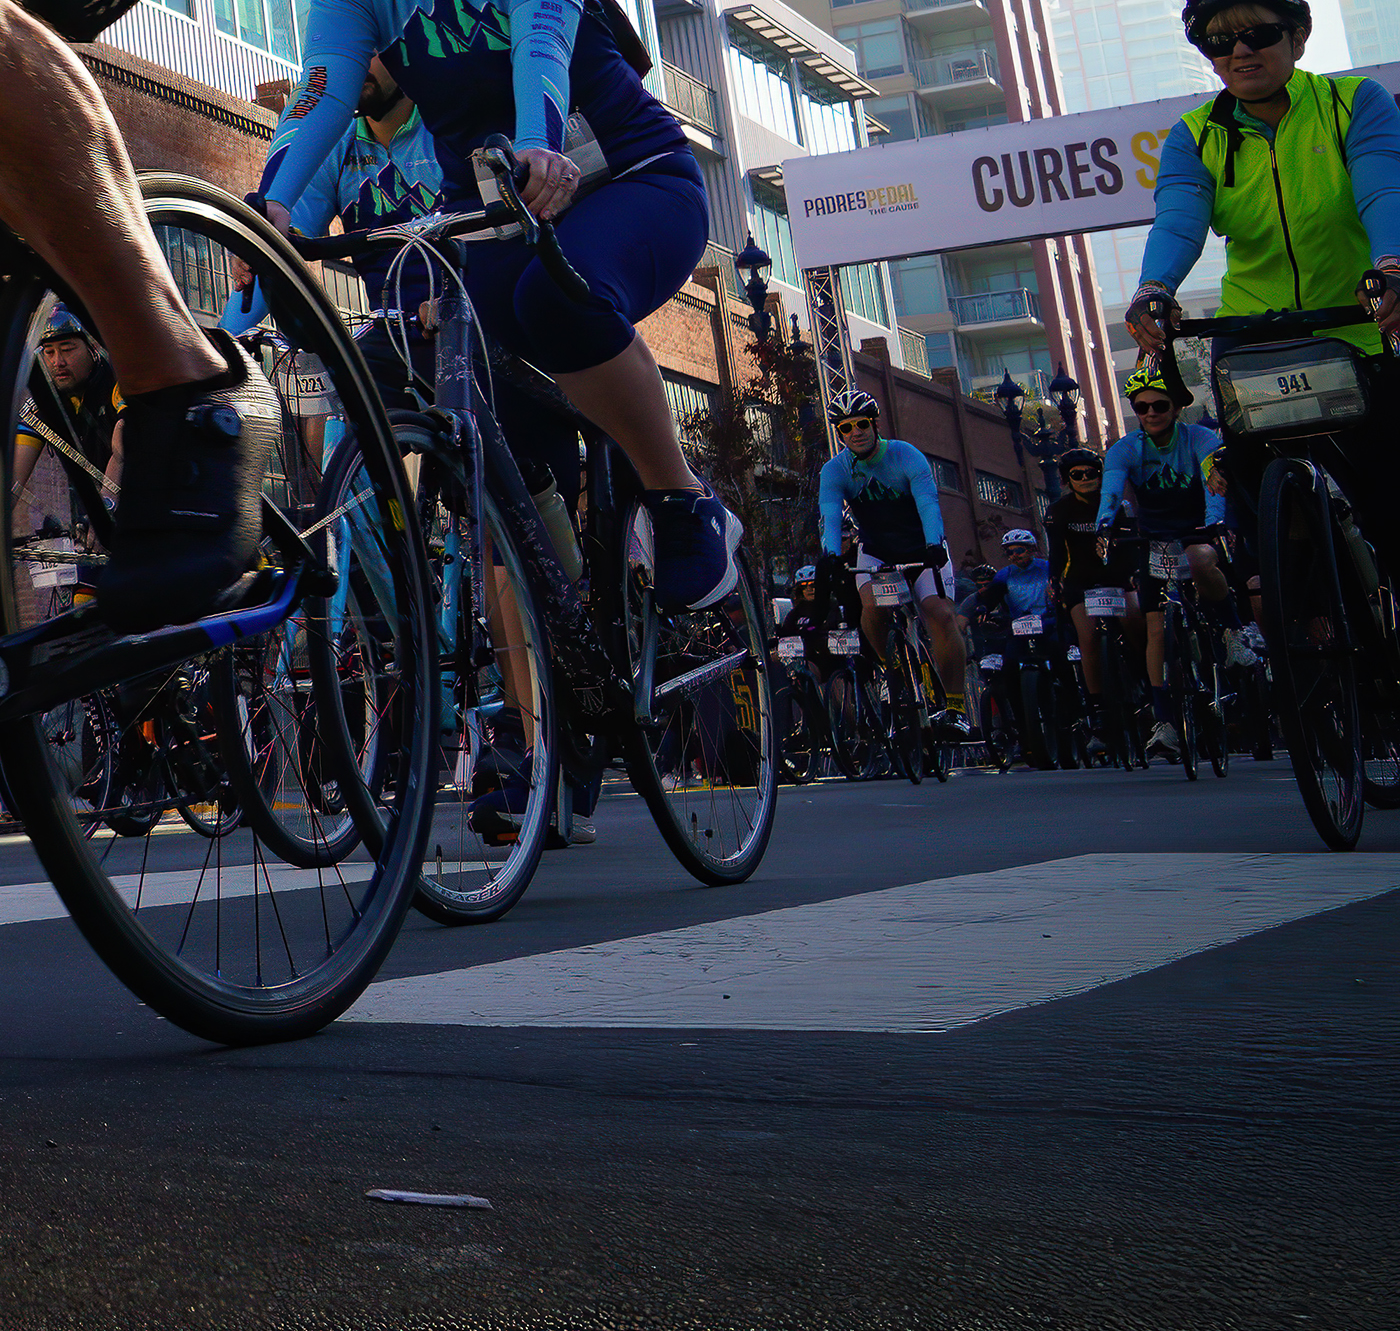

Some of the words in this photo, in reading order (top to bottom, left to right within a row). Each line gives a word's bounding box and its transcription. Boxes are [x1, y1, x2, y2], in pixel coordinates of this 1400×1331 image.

[971, 137, 1124, 213] CURES
[868, 207, 887, 216] THE
[888, 202, 919, 213] CAUSE
[1277, 372, 1313, 395] 941
